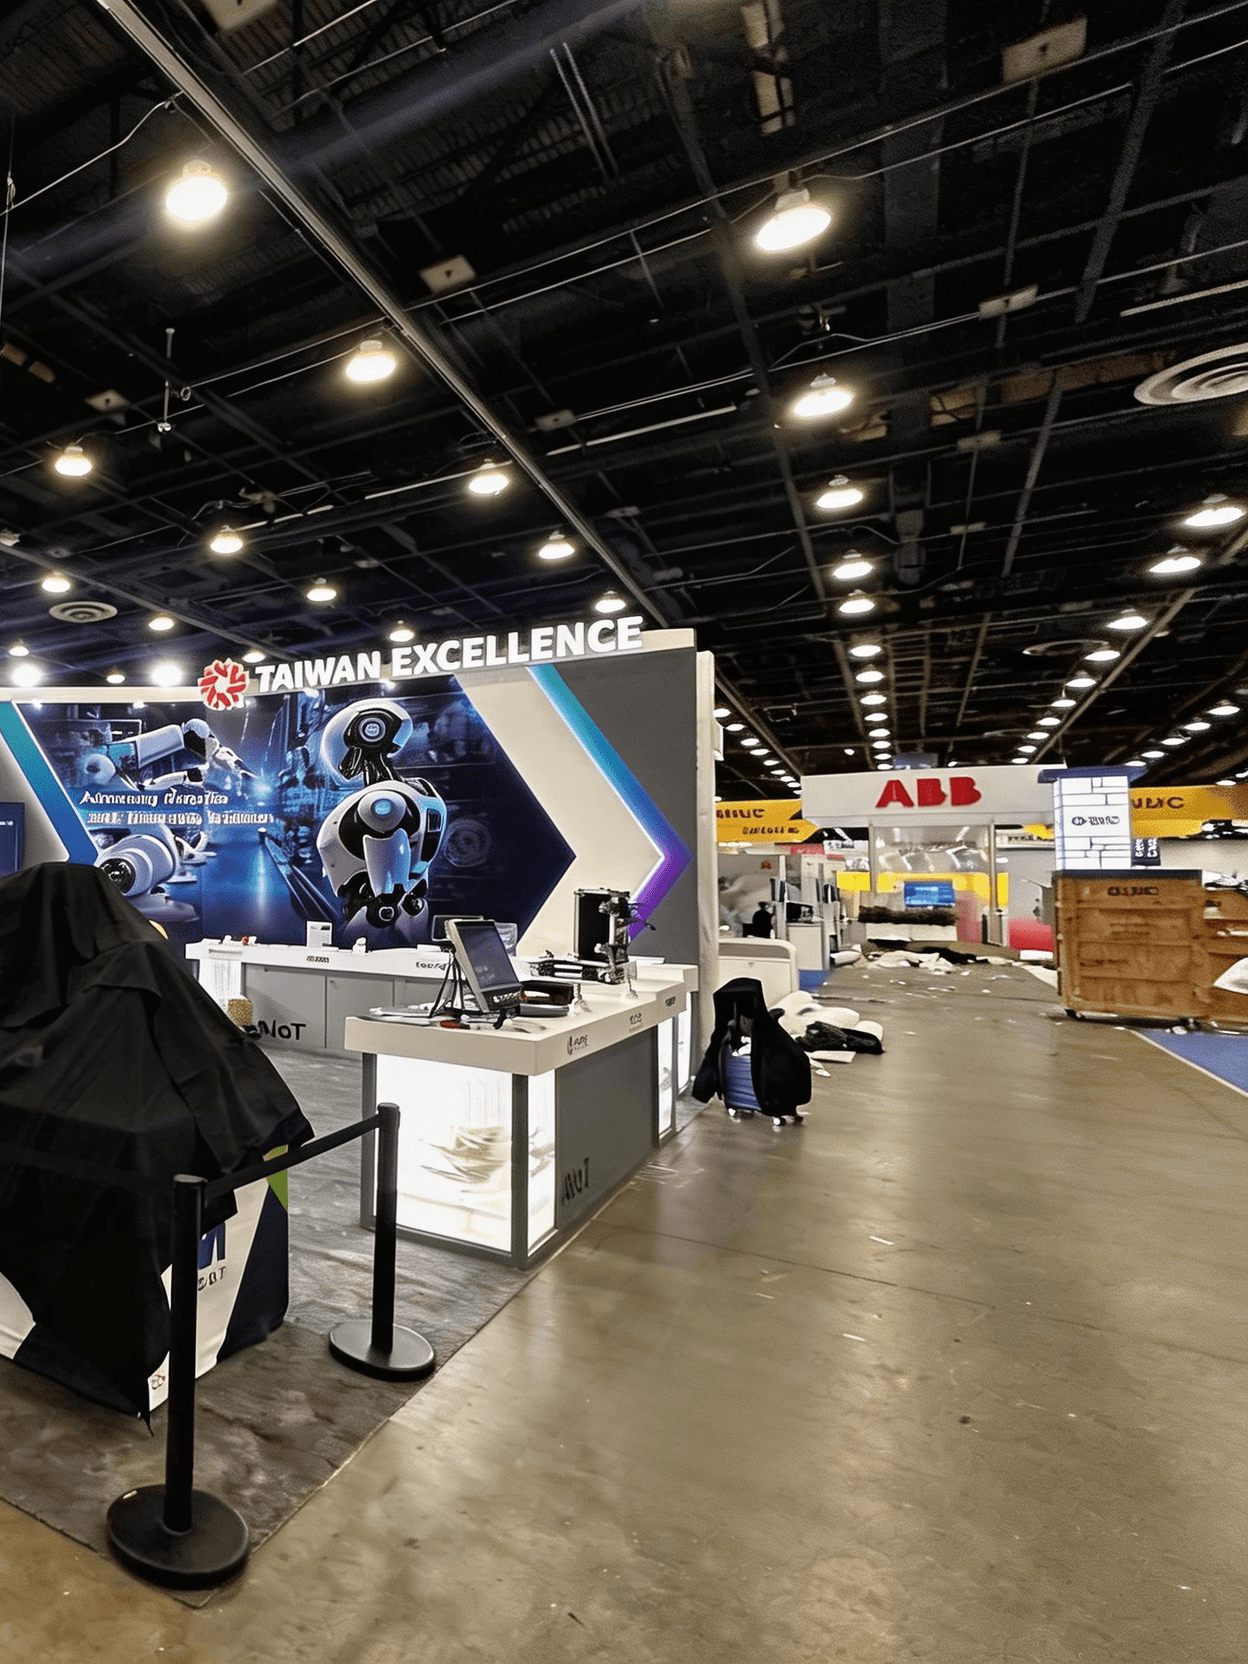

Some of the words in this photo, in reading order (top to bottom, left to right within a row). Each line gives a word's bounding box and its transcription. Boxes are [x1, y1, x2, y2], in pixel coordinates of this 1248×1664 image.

[255, 650, 380, 693] TAIWAN
[391, 616, 643, 678] EXCELLENCE
[875, 776, 982, 809] ABB
